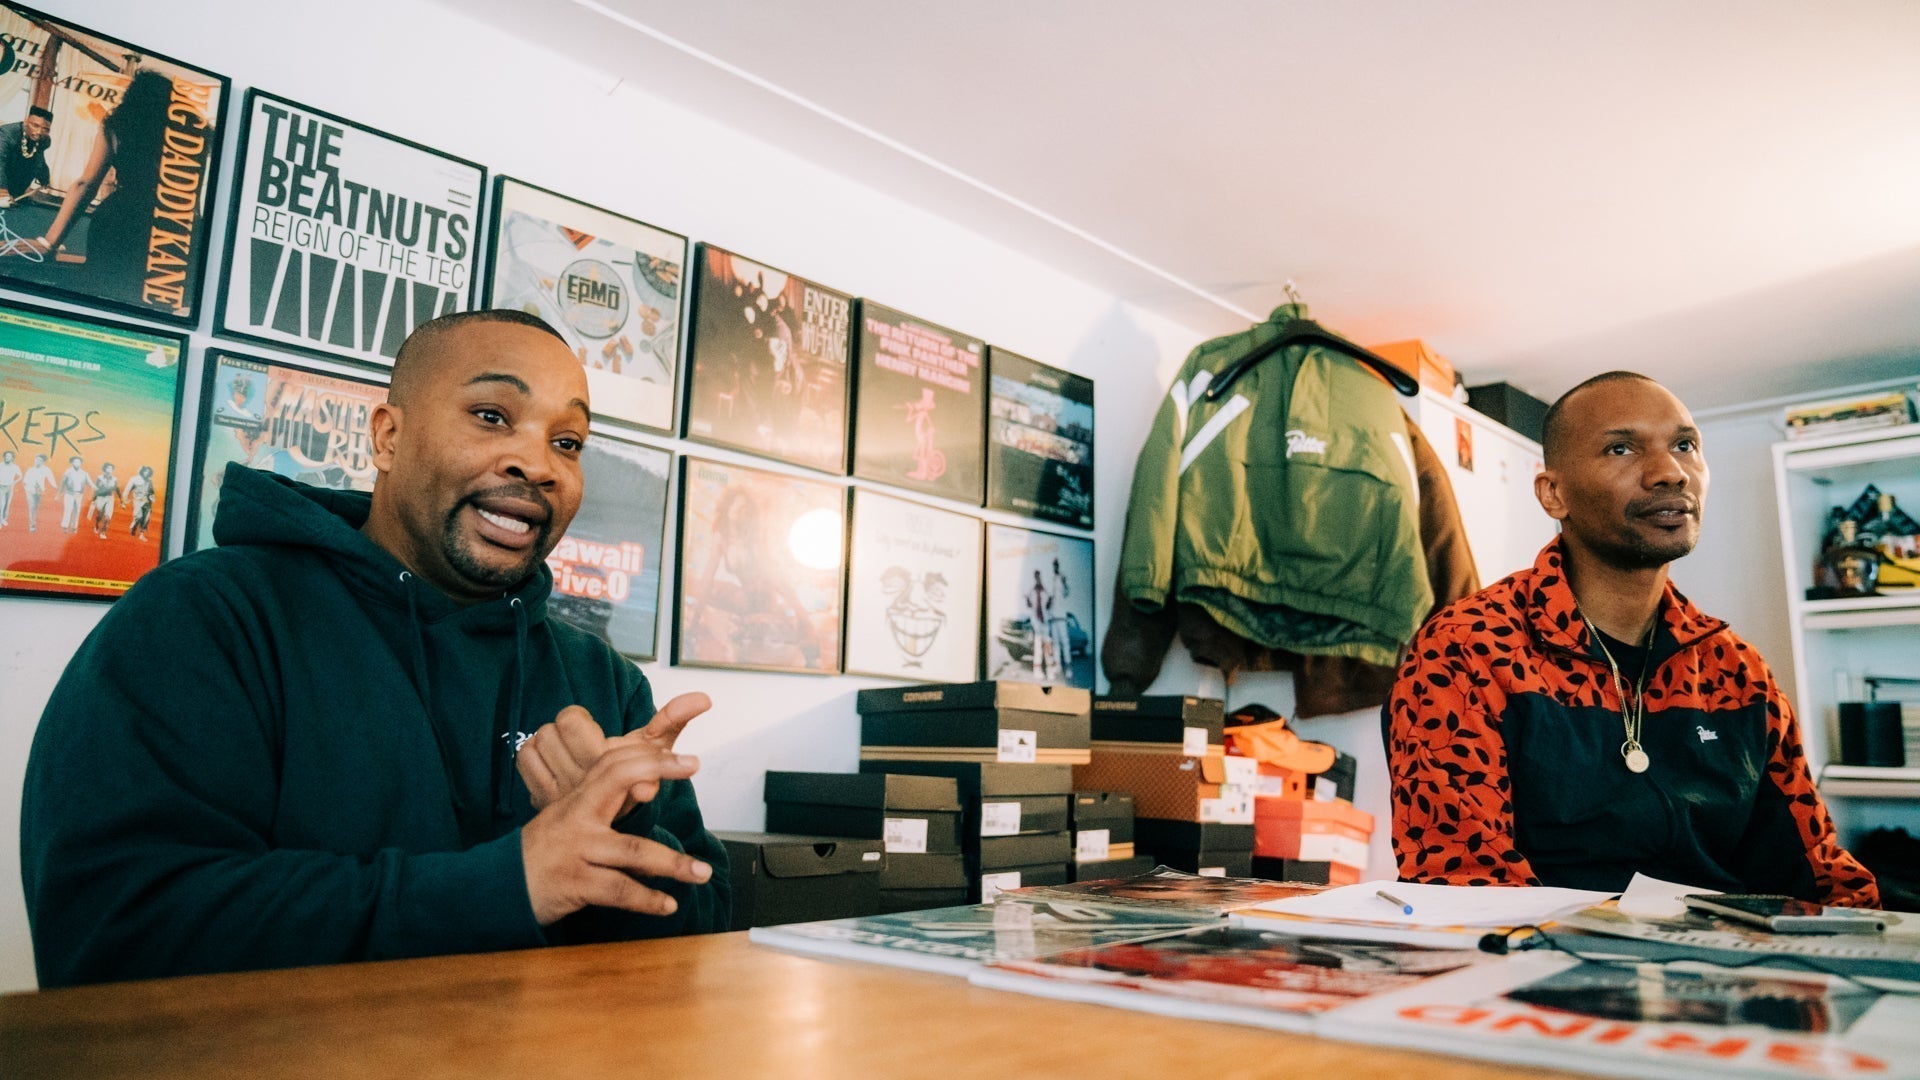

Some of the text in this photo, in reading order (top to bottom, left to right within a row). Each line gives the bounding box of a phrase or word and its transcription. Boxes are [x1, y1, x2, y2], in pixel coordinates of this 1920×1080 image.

[168, 75, 212, 128] BIG
[261, 103, 344, 172] THE
[154, 127, 205, 231] DADDY
[257, 157, 469, 261] BEATNUTS
[142, 226, 192, 309] KANE
[253, 206, 465, 290] REIGN OF THE TEC
[804, 287, 848, 325] ENTER
[806, 310, 847, 336] THE
